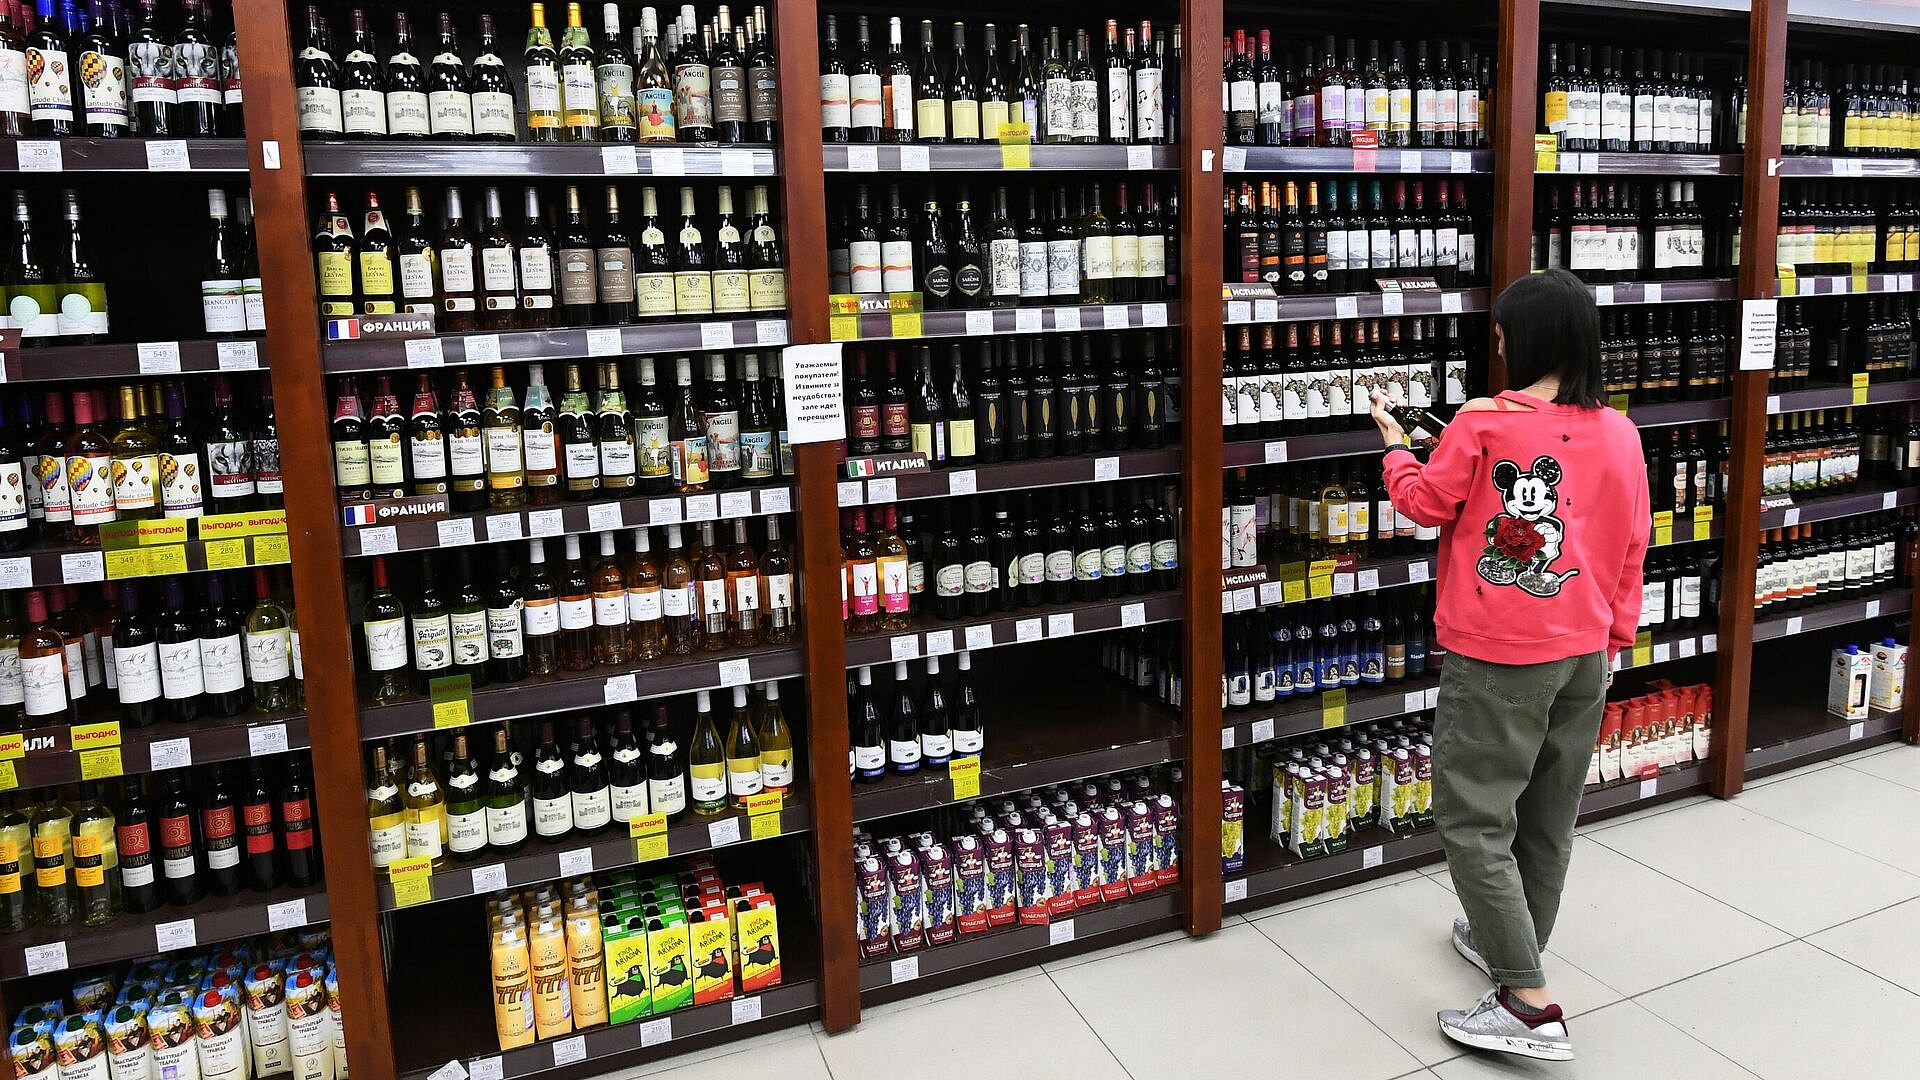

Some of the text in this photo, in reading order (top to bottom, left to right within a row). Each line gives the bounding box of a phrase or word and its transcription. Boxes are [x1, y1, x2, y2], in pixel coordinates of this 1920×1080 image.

[1401, 279, 1438, 290] АБХАЗИЯ
[1231, 287, 1274, 297] ИСПАНИЯ
[363, 321, 431, 333] ФРАНЦИЯ
[795, 381, 832, 391] Извините
[792, 392, 836, 402] неудобства,
[801, 403, 820, 411] зале
[797, 413, 840, 422] переоценка
[877, 458, 925, 472] ИТАЛИЯ
[379, 502, 445, 518] ФРАНЦИЯ
[202, 520, 244, 531] ВЫГОДНО
[499, 521, 511, 529] 379
[541, 517, 553, 525] 379
[451, 525, 463, 533] 379
[373, 534, 386, 542] 379
[220, 547, 234, 555] 289
[268, 543, 282, 551] 289
[77, 560, 91, 568] 329
[120, 556, 134, 564] 349
[4, 566, 18, 574] 329
[1226, 571, 1267, 585] ИСПАНИЯ
[454, 624, 482, 636] Gargotte
[74, 730, 117, 741] ВЫГОДНО
[23, 736, 55, 752] ИЛИ
[950, 762, 978, 772] ВЫГОДНО
[749, 798, 780, 809] ВЫГОДНО
[631, 818, 664, 830] ВЫГОДНО
[571, 856, 583, 864] 259
[392, 862, 429, 874] ВЫГОДНО
[484, 872, 497, 880] 259
[746, 919, 771, 937] ARIADNA
[699, 931, 725, 949] ARIADNA
[657, 938, 684, 957] ARIADNA
[40, 951, 54, 959] 399
[615, 948, 642, 967] ARIADNA
[571, 961, 601, 986] 777
[534, 969, 566, 994] 777
[496, 979, 528, 1005] 777
